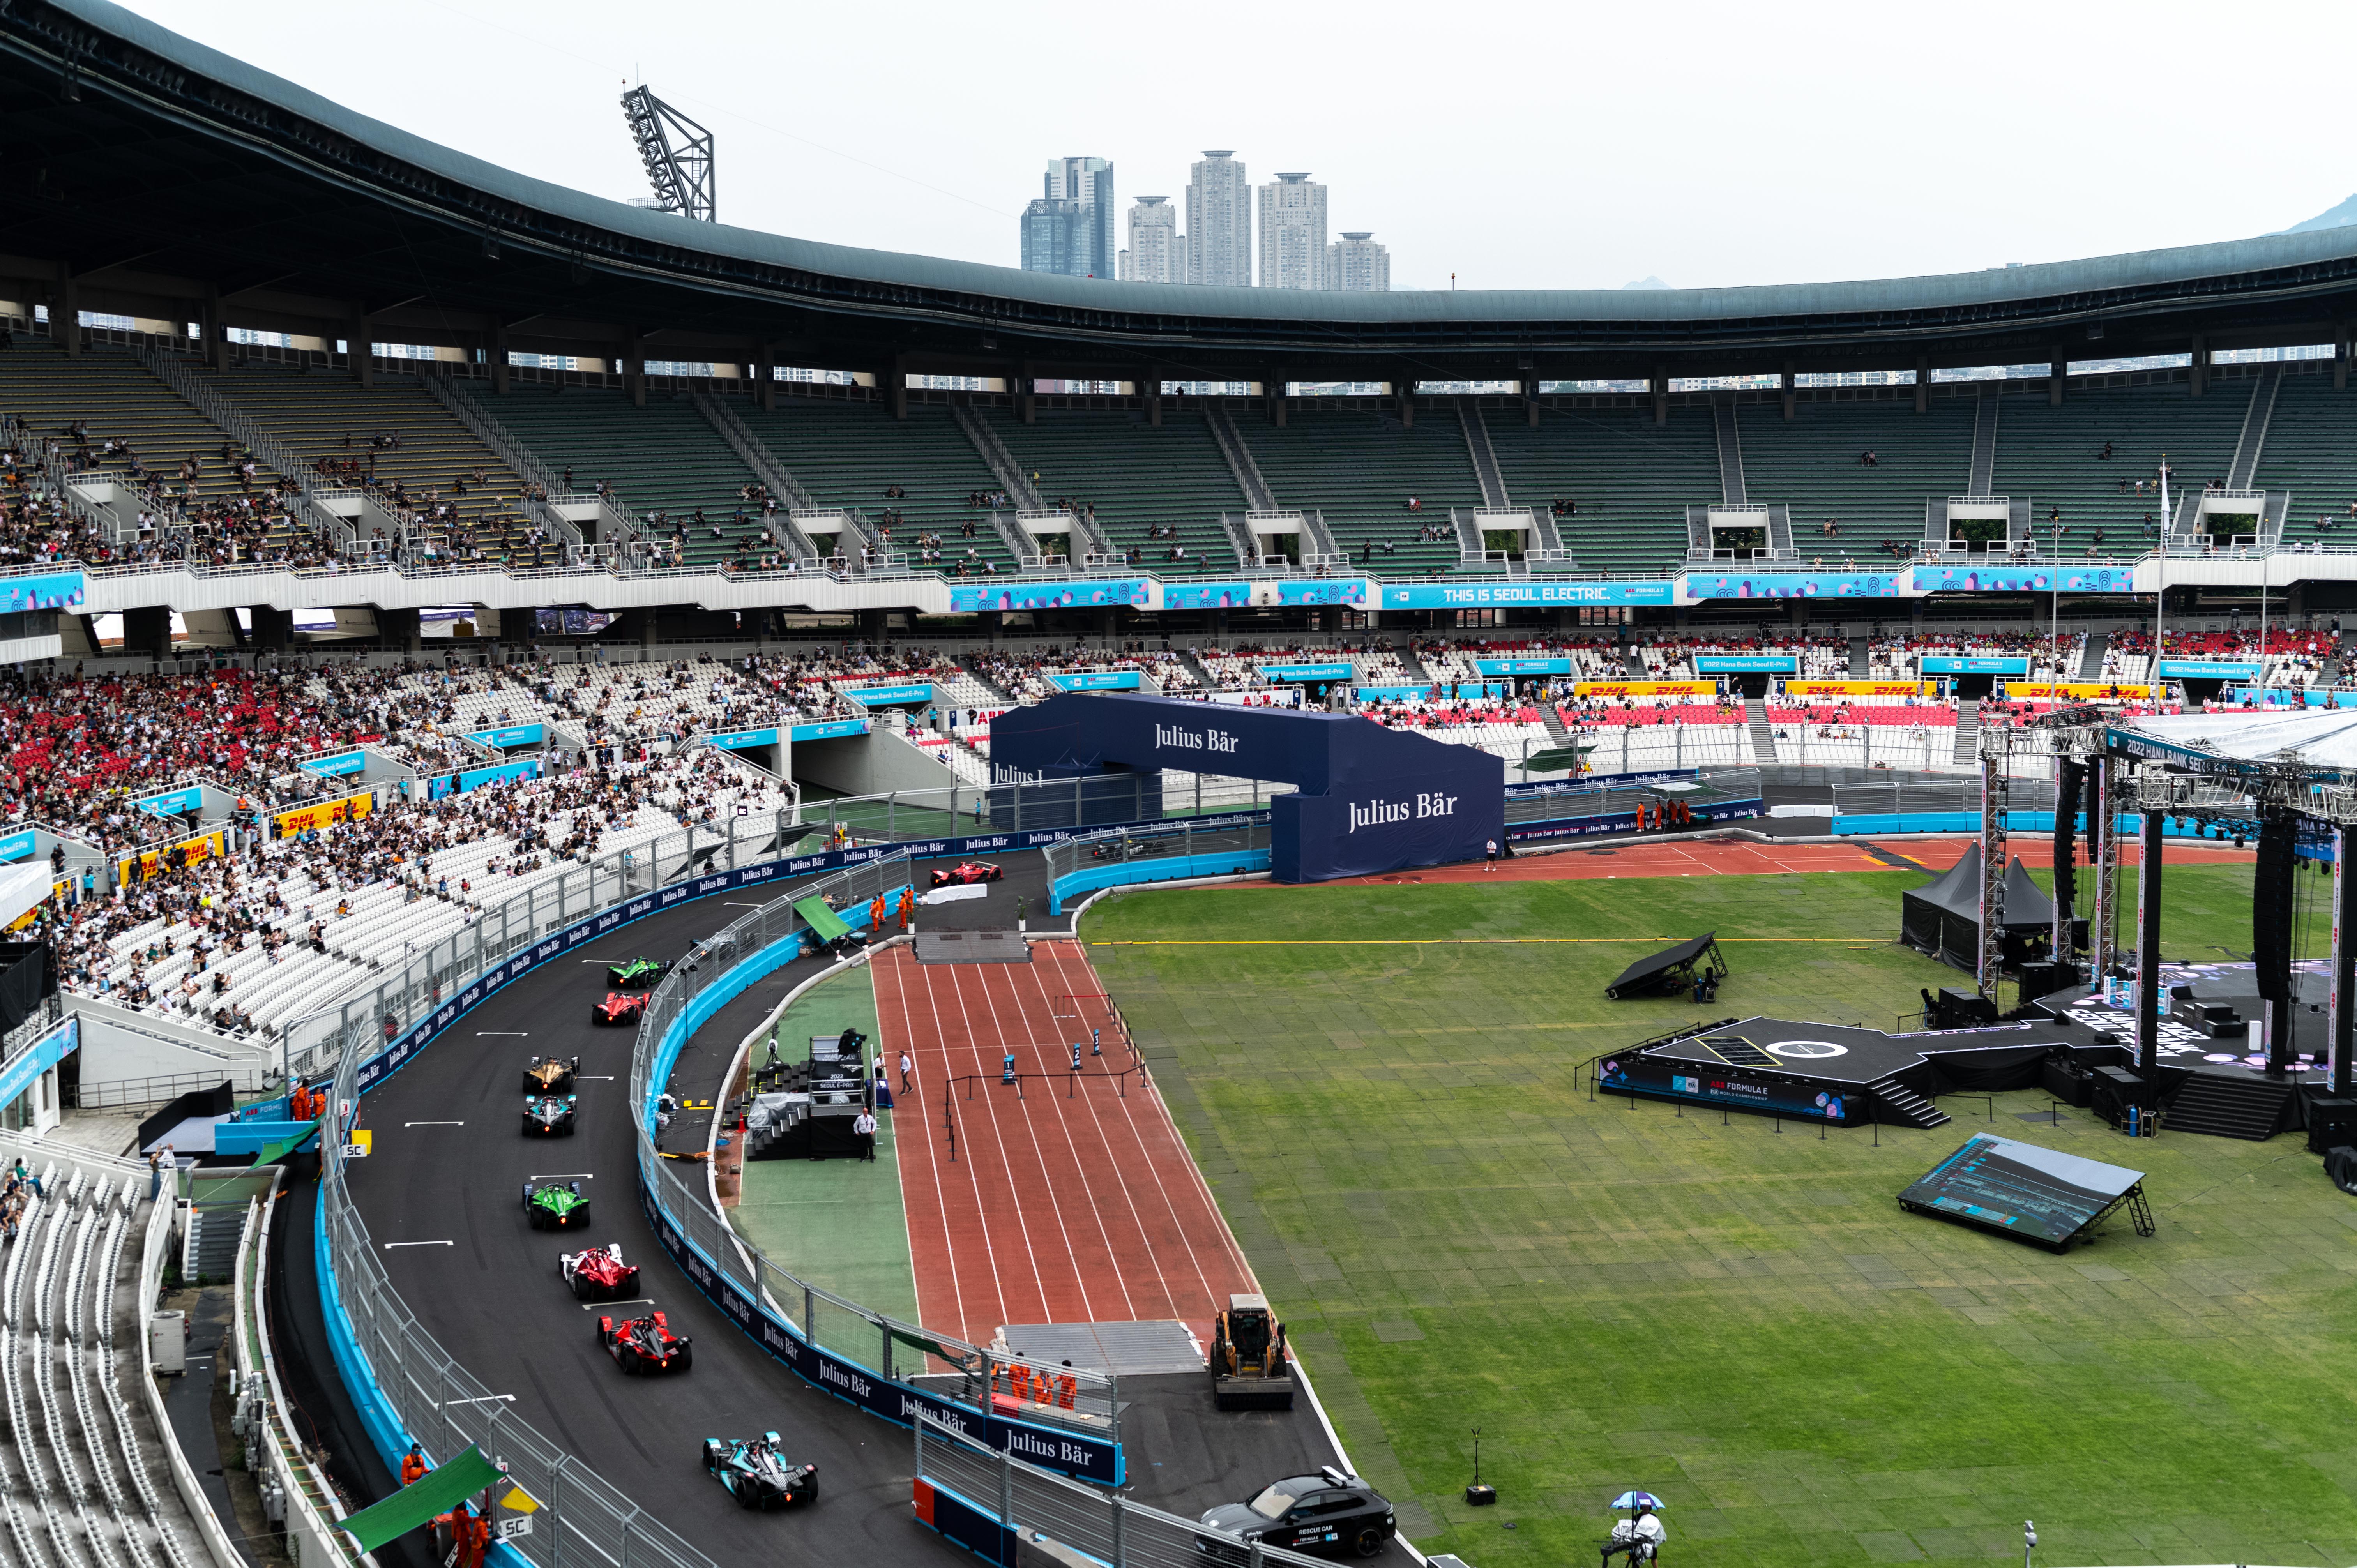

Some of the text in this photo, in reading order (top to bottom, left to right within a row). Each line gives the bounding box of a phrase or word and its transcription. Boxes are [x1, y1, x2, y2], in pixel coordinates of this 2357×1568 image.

[1444, 588, 1610, 602] THIS IS SEOUL. ELECTRIC.
[1590, 687, 1630, 696] DHL
[1656, 686, 1696, 695] DHL
[1806, 686, 1848, 695] DHL
[1873, 686, 1915, 695] DHL
[2029, 688, 2070, 697] DHL
[1156, 724, 1239, 752] Julius Bär
[2127, 738, 2165, 759] 2022 HANA
[1349, 792, 1458, 833] Julius Bär
[288, 813, 316, 830] DHL
[1586, 825, 1600, 833] Julius
[966, 837, 1008, 850] Julius Bär
[1029, 832, 1070, 844] Julius Bär
[929, 842, 945, 852] Bär
[844, 849, 883, 863] Julius Bär
[790, 857, 825, 872] Julius Bär
[742, 867, 774, 882] Julius Bär
[700, 877, 727, 893] Julius Bär
[663, 888, 687, 905] Julius Bär
[630, 900, 651, 917] Julius Bär
[599, 917, 611, 931] Julius
[569, 931, 581, 945] Julius
[539, 940, 560, 960] Julius Bär
[2062, 1008, 2122, 1031] SEOUL
[1095, 1035, 1099, 1045] 3
[1075, 1049, 1079, 1059] 2
[370, 1065, 380, 1079] Bär
[1710, 1081, 1725, 1089] ABB
[1727, 1082, 1762, 1094] FORMULA
[245, 1108, 258, 1116] ABB
[348, 1146, 361, 1156] SC
[689, 1253, 711, 1287] Julius Bär
[723, 1286, 750, 1323] Julius Bär
[765, 1322, 798, 1360] Julius Bär
[820, 1359, 871, 1397] Julius Bär
[942, 1409, 966, 1432] Bär
[1007, 1429, 1092, 1466] Julius Bär
[506, 1519, 524, 1536] SC
[1299, 1527, 1321, 1535] RESCUE
